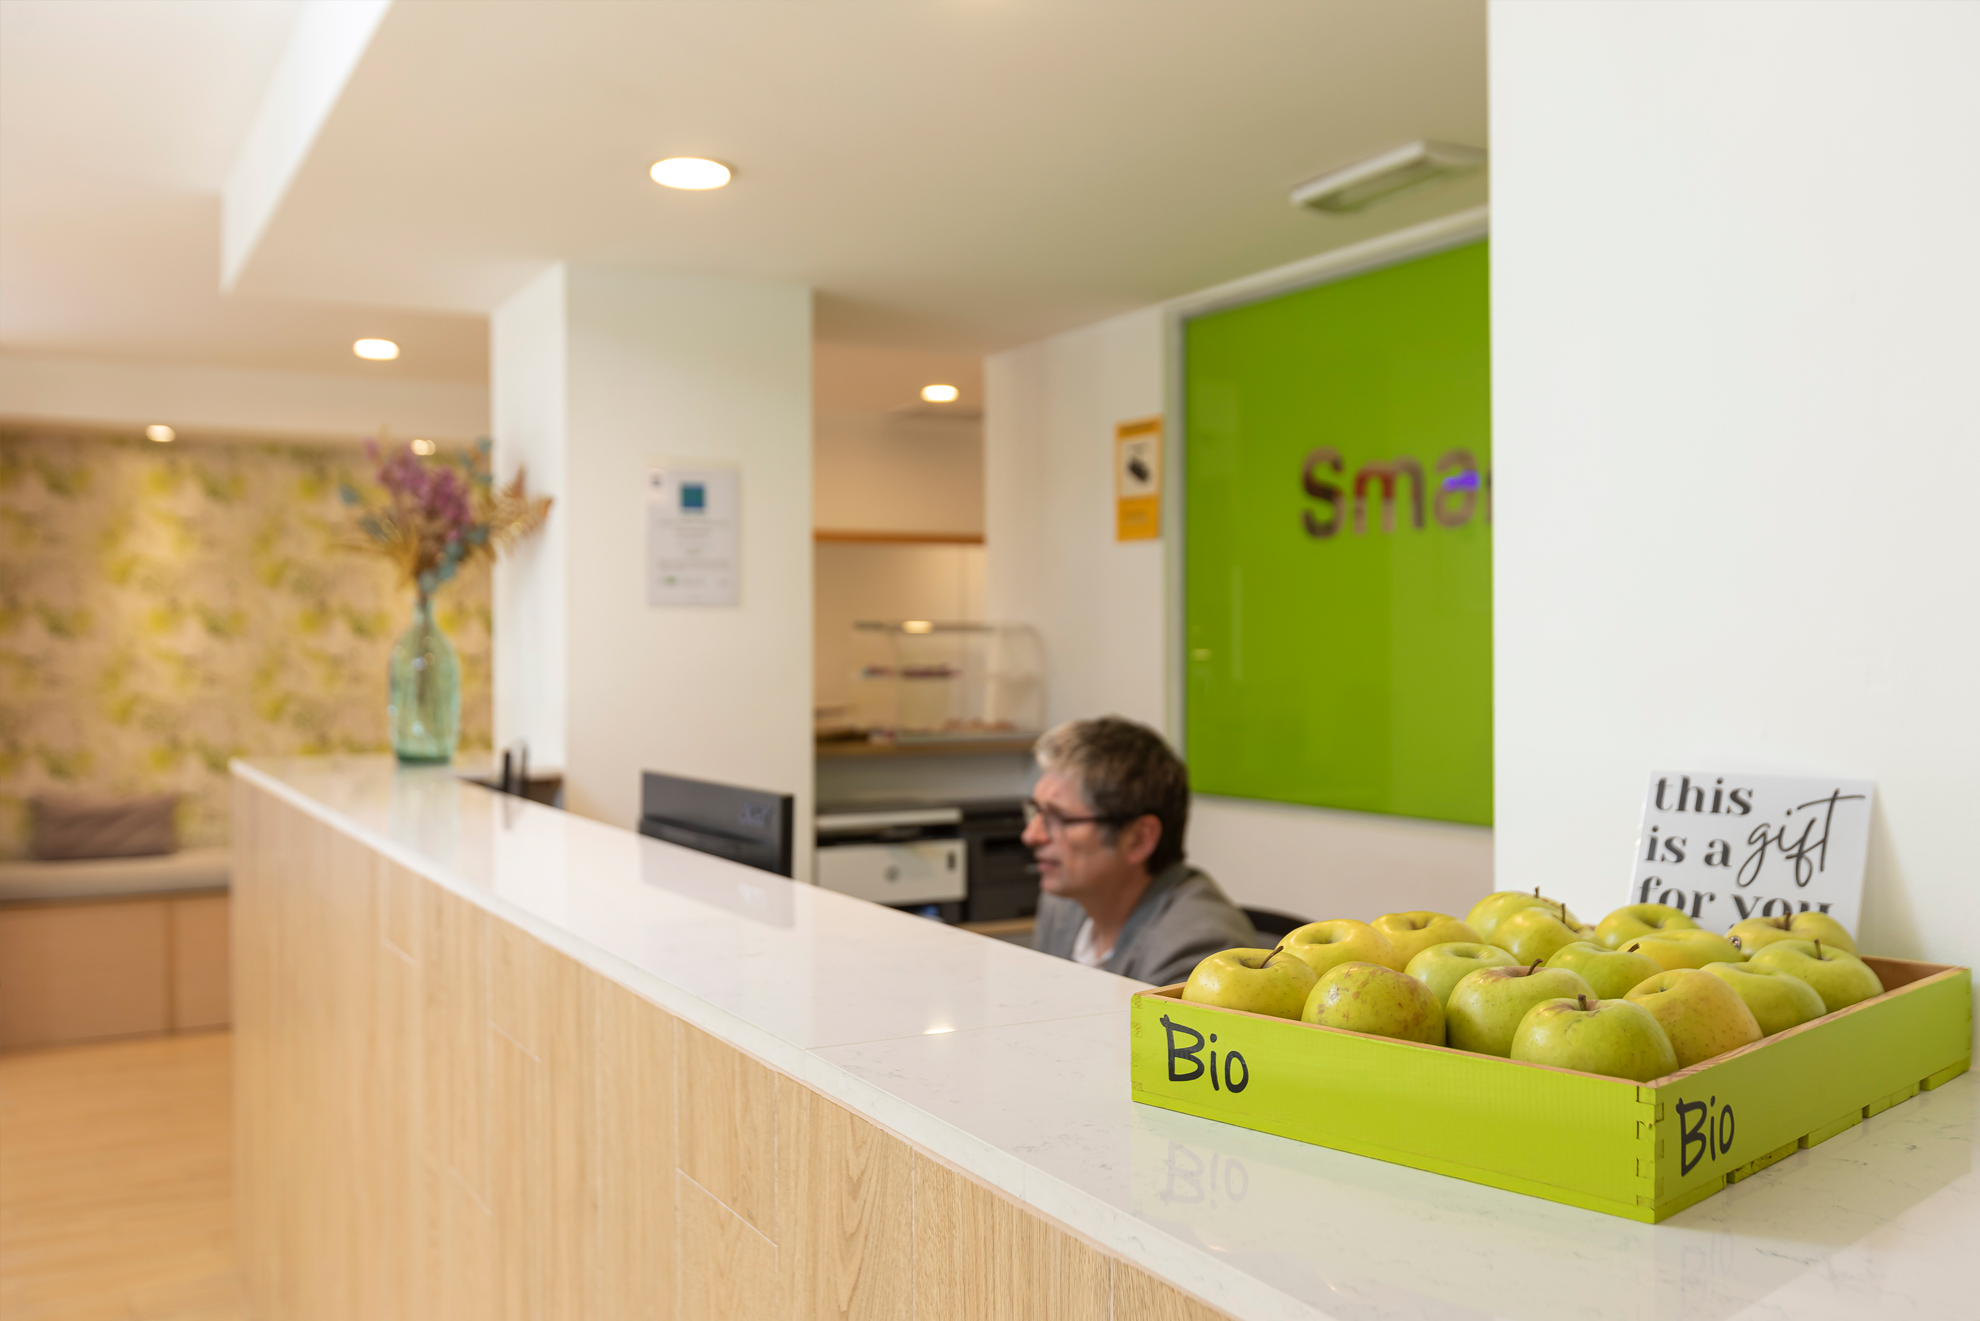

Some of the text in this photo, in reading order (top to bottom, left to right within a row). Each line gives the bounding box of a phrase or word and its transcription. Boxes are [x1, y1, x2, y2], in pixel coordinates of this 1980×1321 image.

[1302, 444, 1492, 540] Sma
[1655, 775, 1754, 816] this
[1644, 787, 1867, 888] is a gift
[1638, 876, 1716, 919] for
[1159, 1013, 1249, 1094] Bio
[1675, 1095, 1736, 1178] Bio
